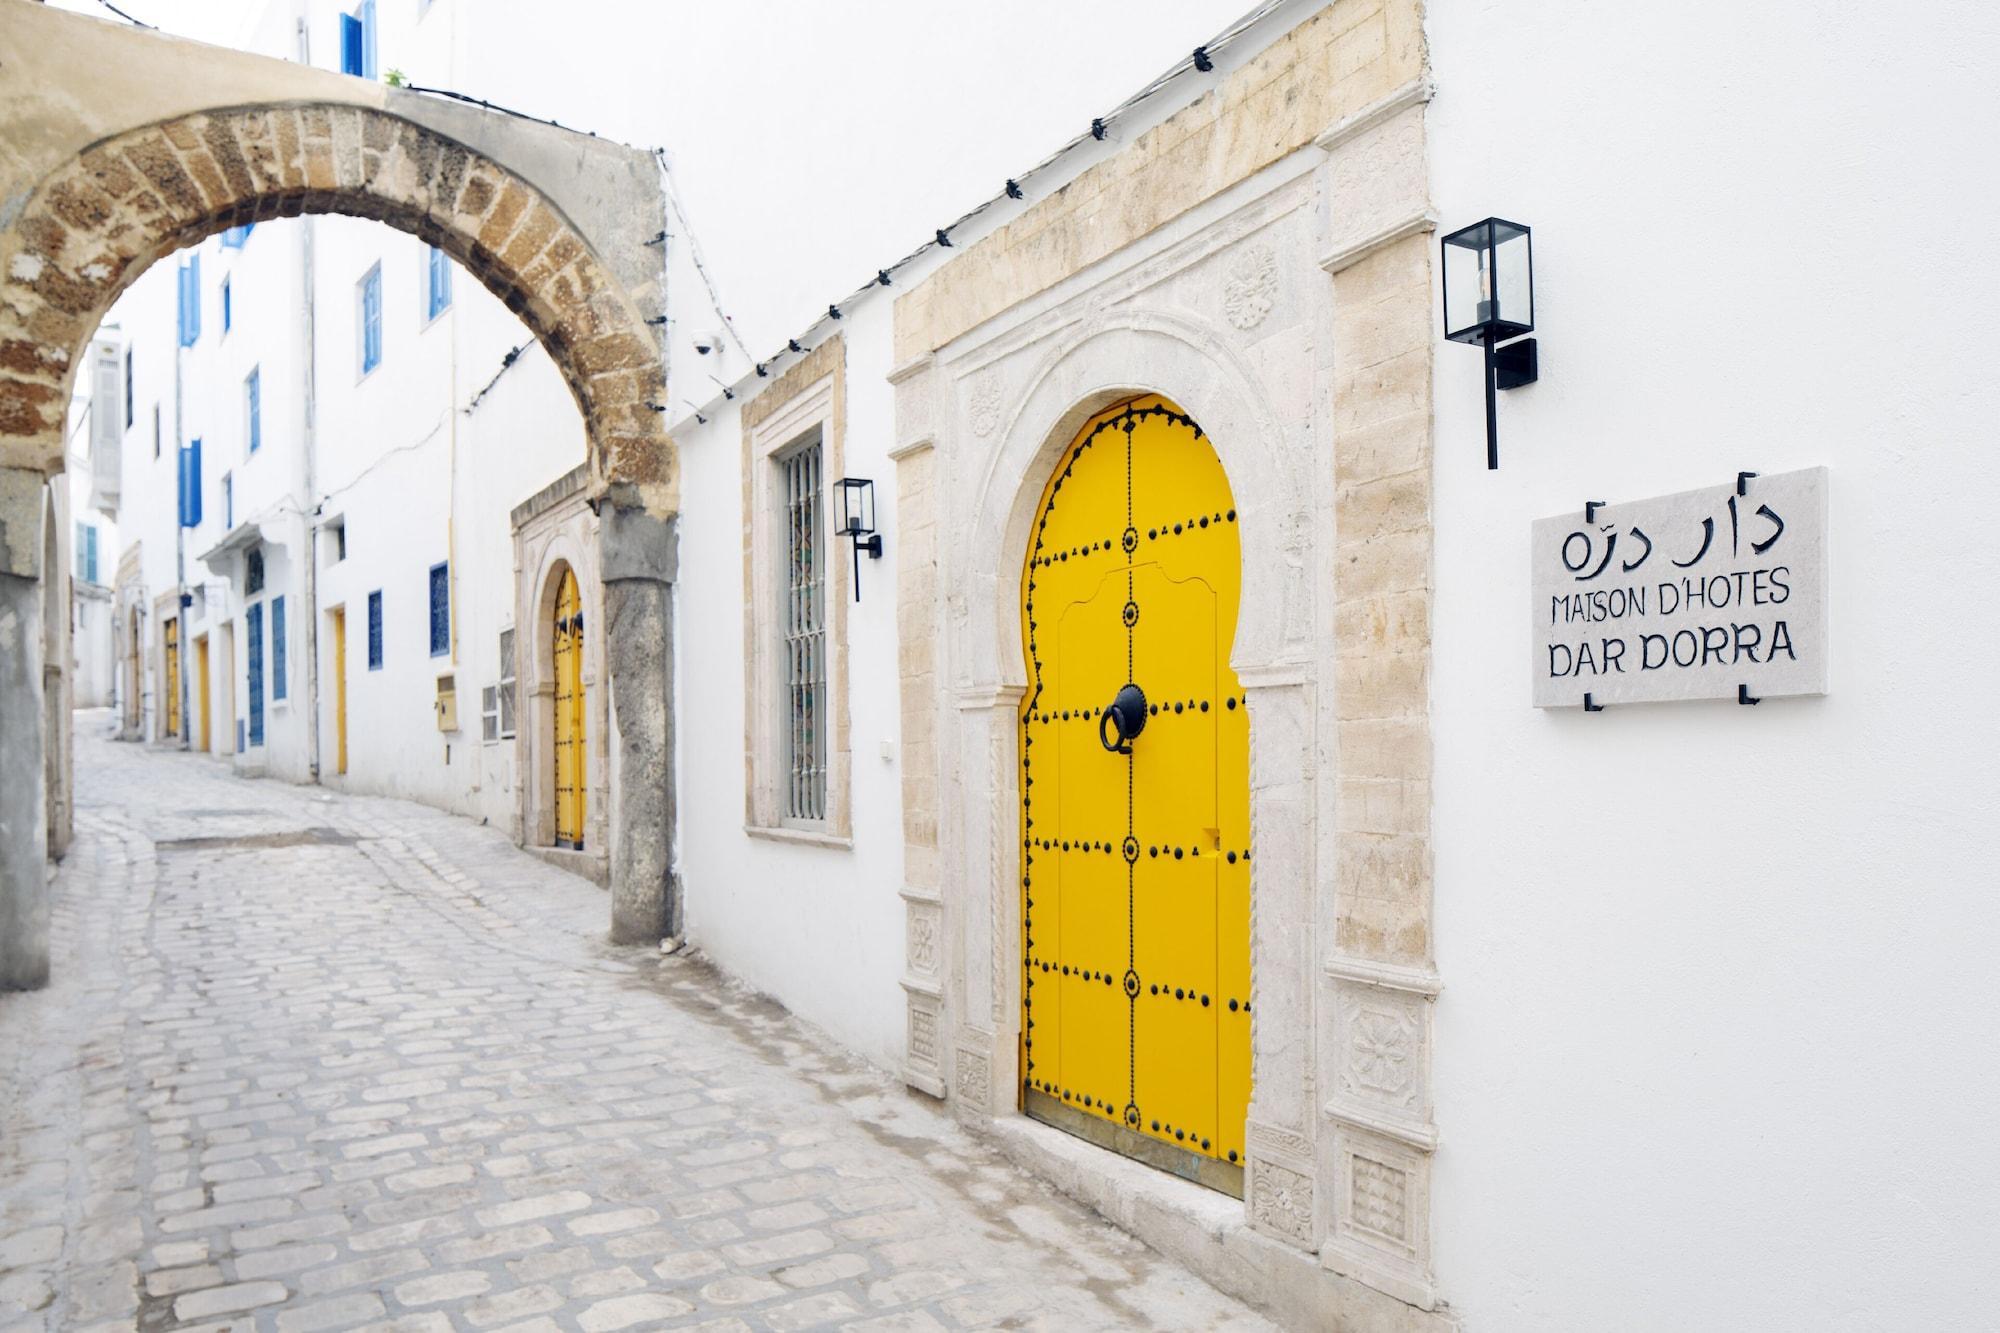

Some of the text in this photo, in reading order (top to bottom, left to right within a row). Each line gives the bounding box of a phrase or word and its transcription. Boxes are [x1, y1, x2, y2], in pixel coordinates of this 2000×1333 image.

[1671, 495, 1784, 568] دار
[1551, 566, 1790, 626] MAISON D'HOTES
[1549, 621, 1797, 678] DAR DORRA
